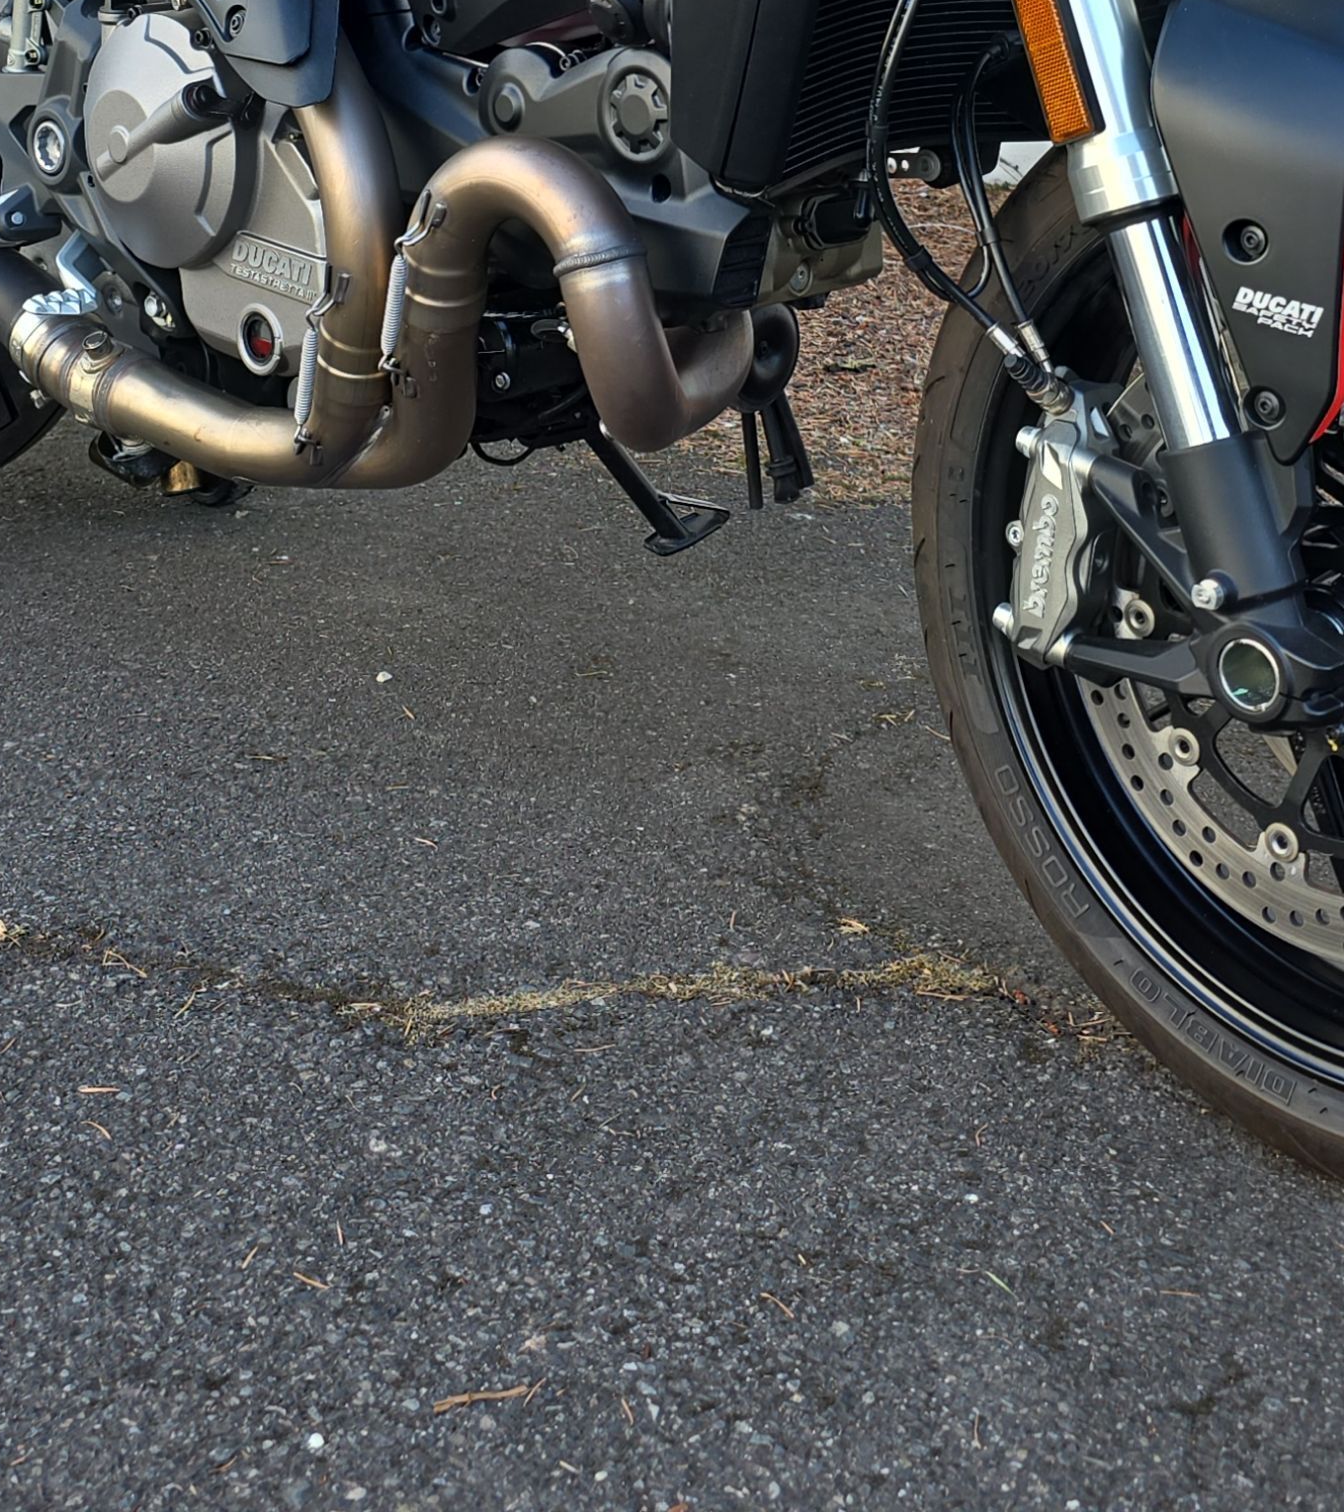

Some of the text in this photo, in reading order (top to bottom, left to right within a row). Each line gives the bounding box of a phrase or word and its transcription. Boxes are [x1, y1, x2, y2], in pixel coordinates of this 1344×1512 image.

[230, 263, 305, 299] TESTASTRETTA
[232, 240, 312, 285] DUCATI
[1234, 286, 1325, 323] DUCATI
[1023, 493, 1059, 618] brembo
[991, 763, 1091, 920] ROSSO
[1128, 967, 1298, 1108] DIABLO
